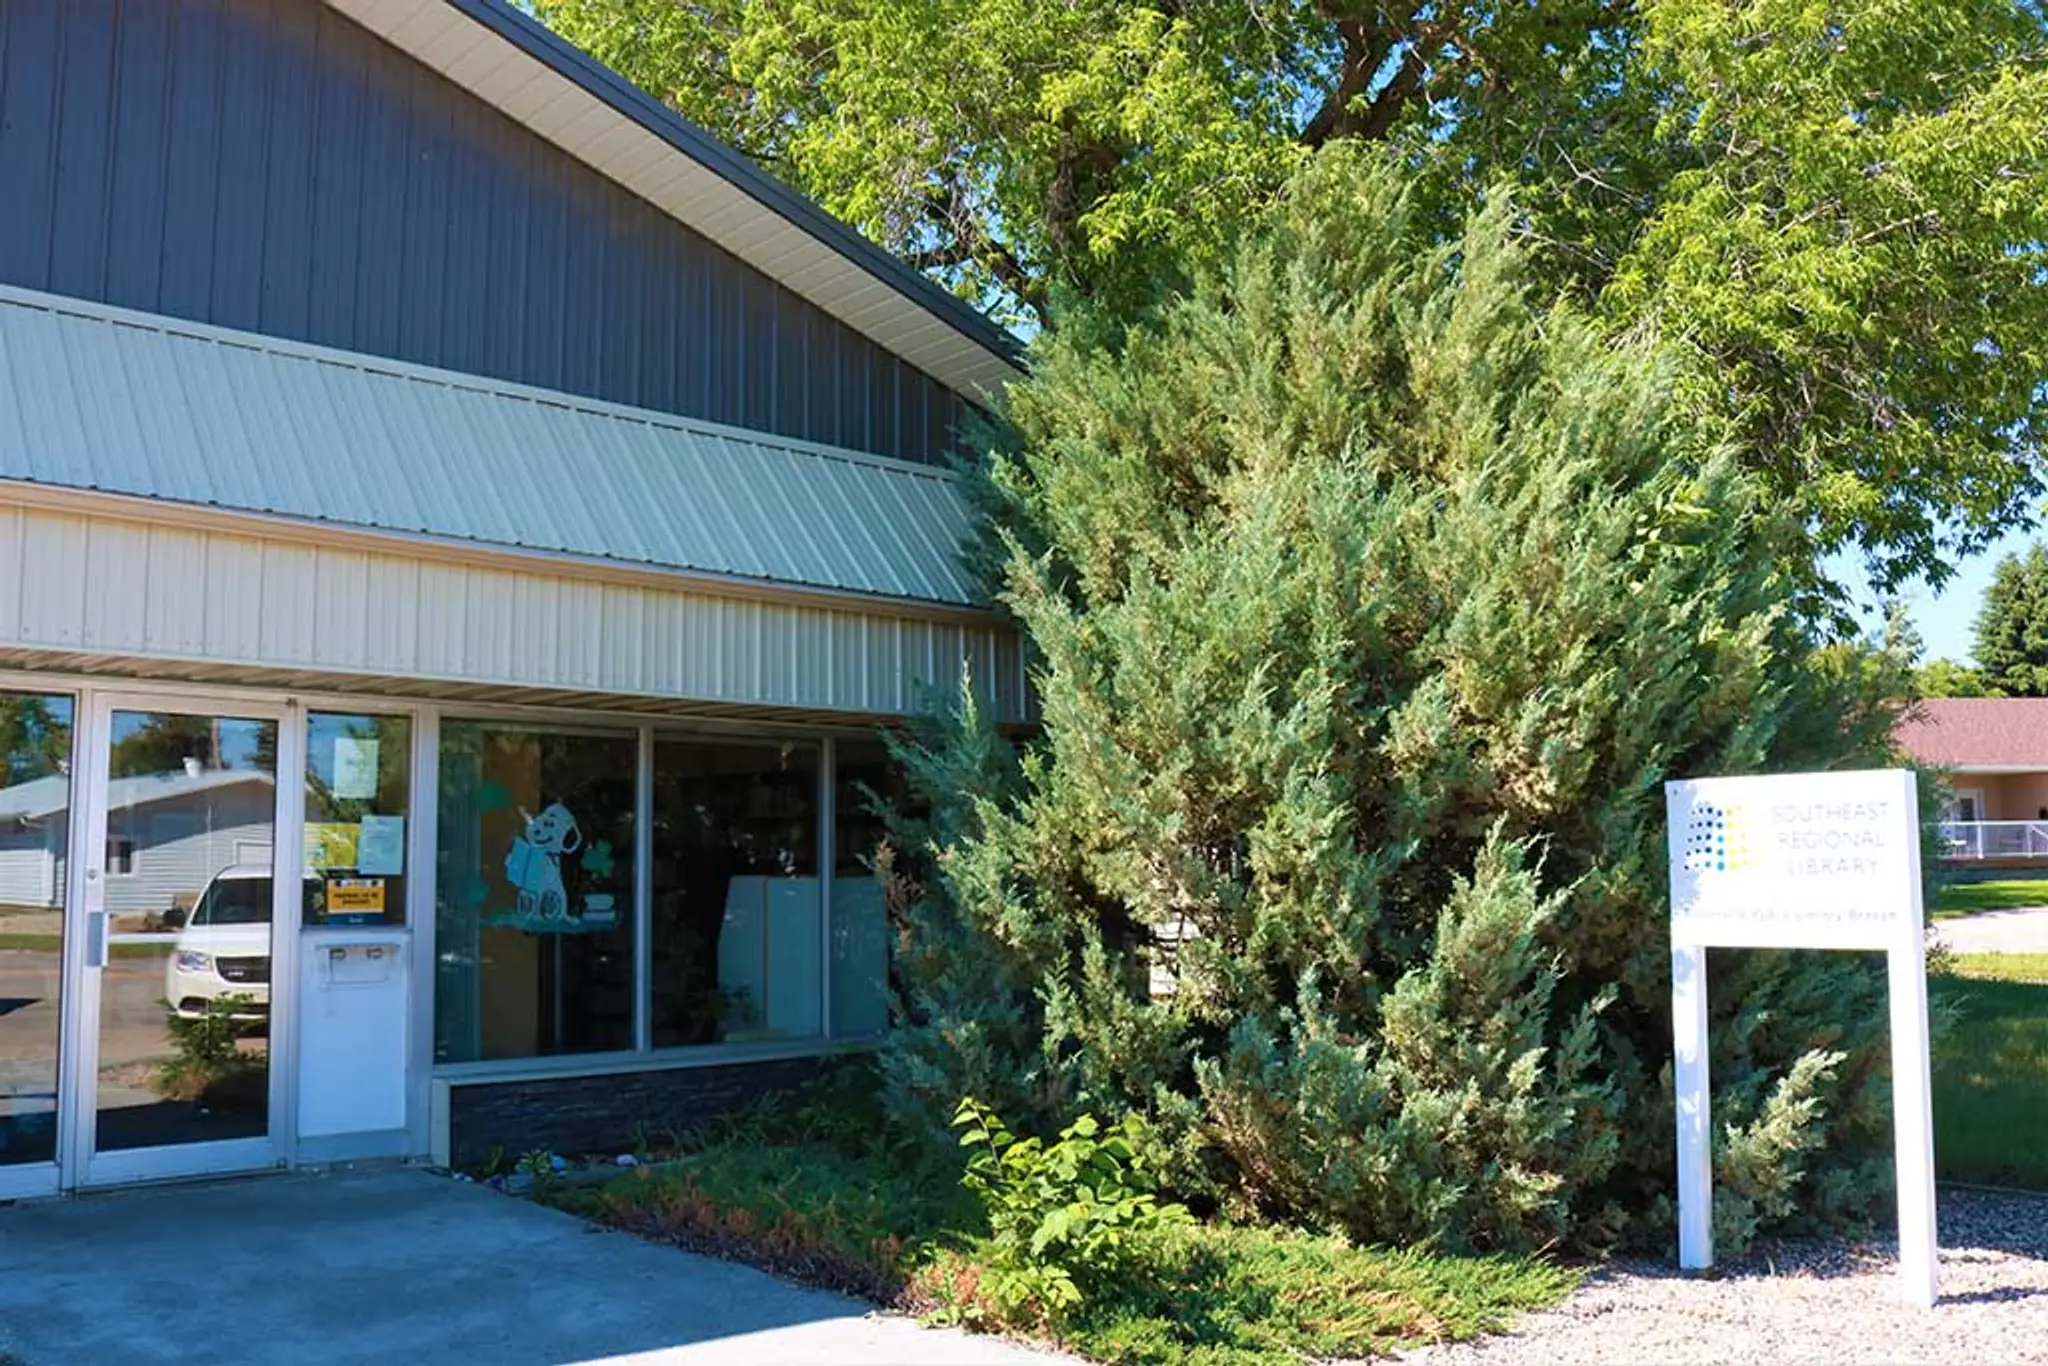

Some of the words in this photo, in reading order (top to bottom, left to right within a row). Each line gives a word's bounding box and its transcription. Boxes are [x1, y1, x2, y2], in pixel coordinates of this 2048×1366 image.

[1771, 802, 1889, 823] SOUTHEAST
[1777, 829, 1887, 850] REGIONAL
[1784, 856, 1880, 876] LIBRARY
